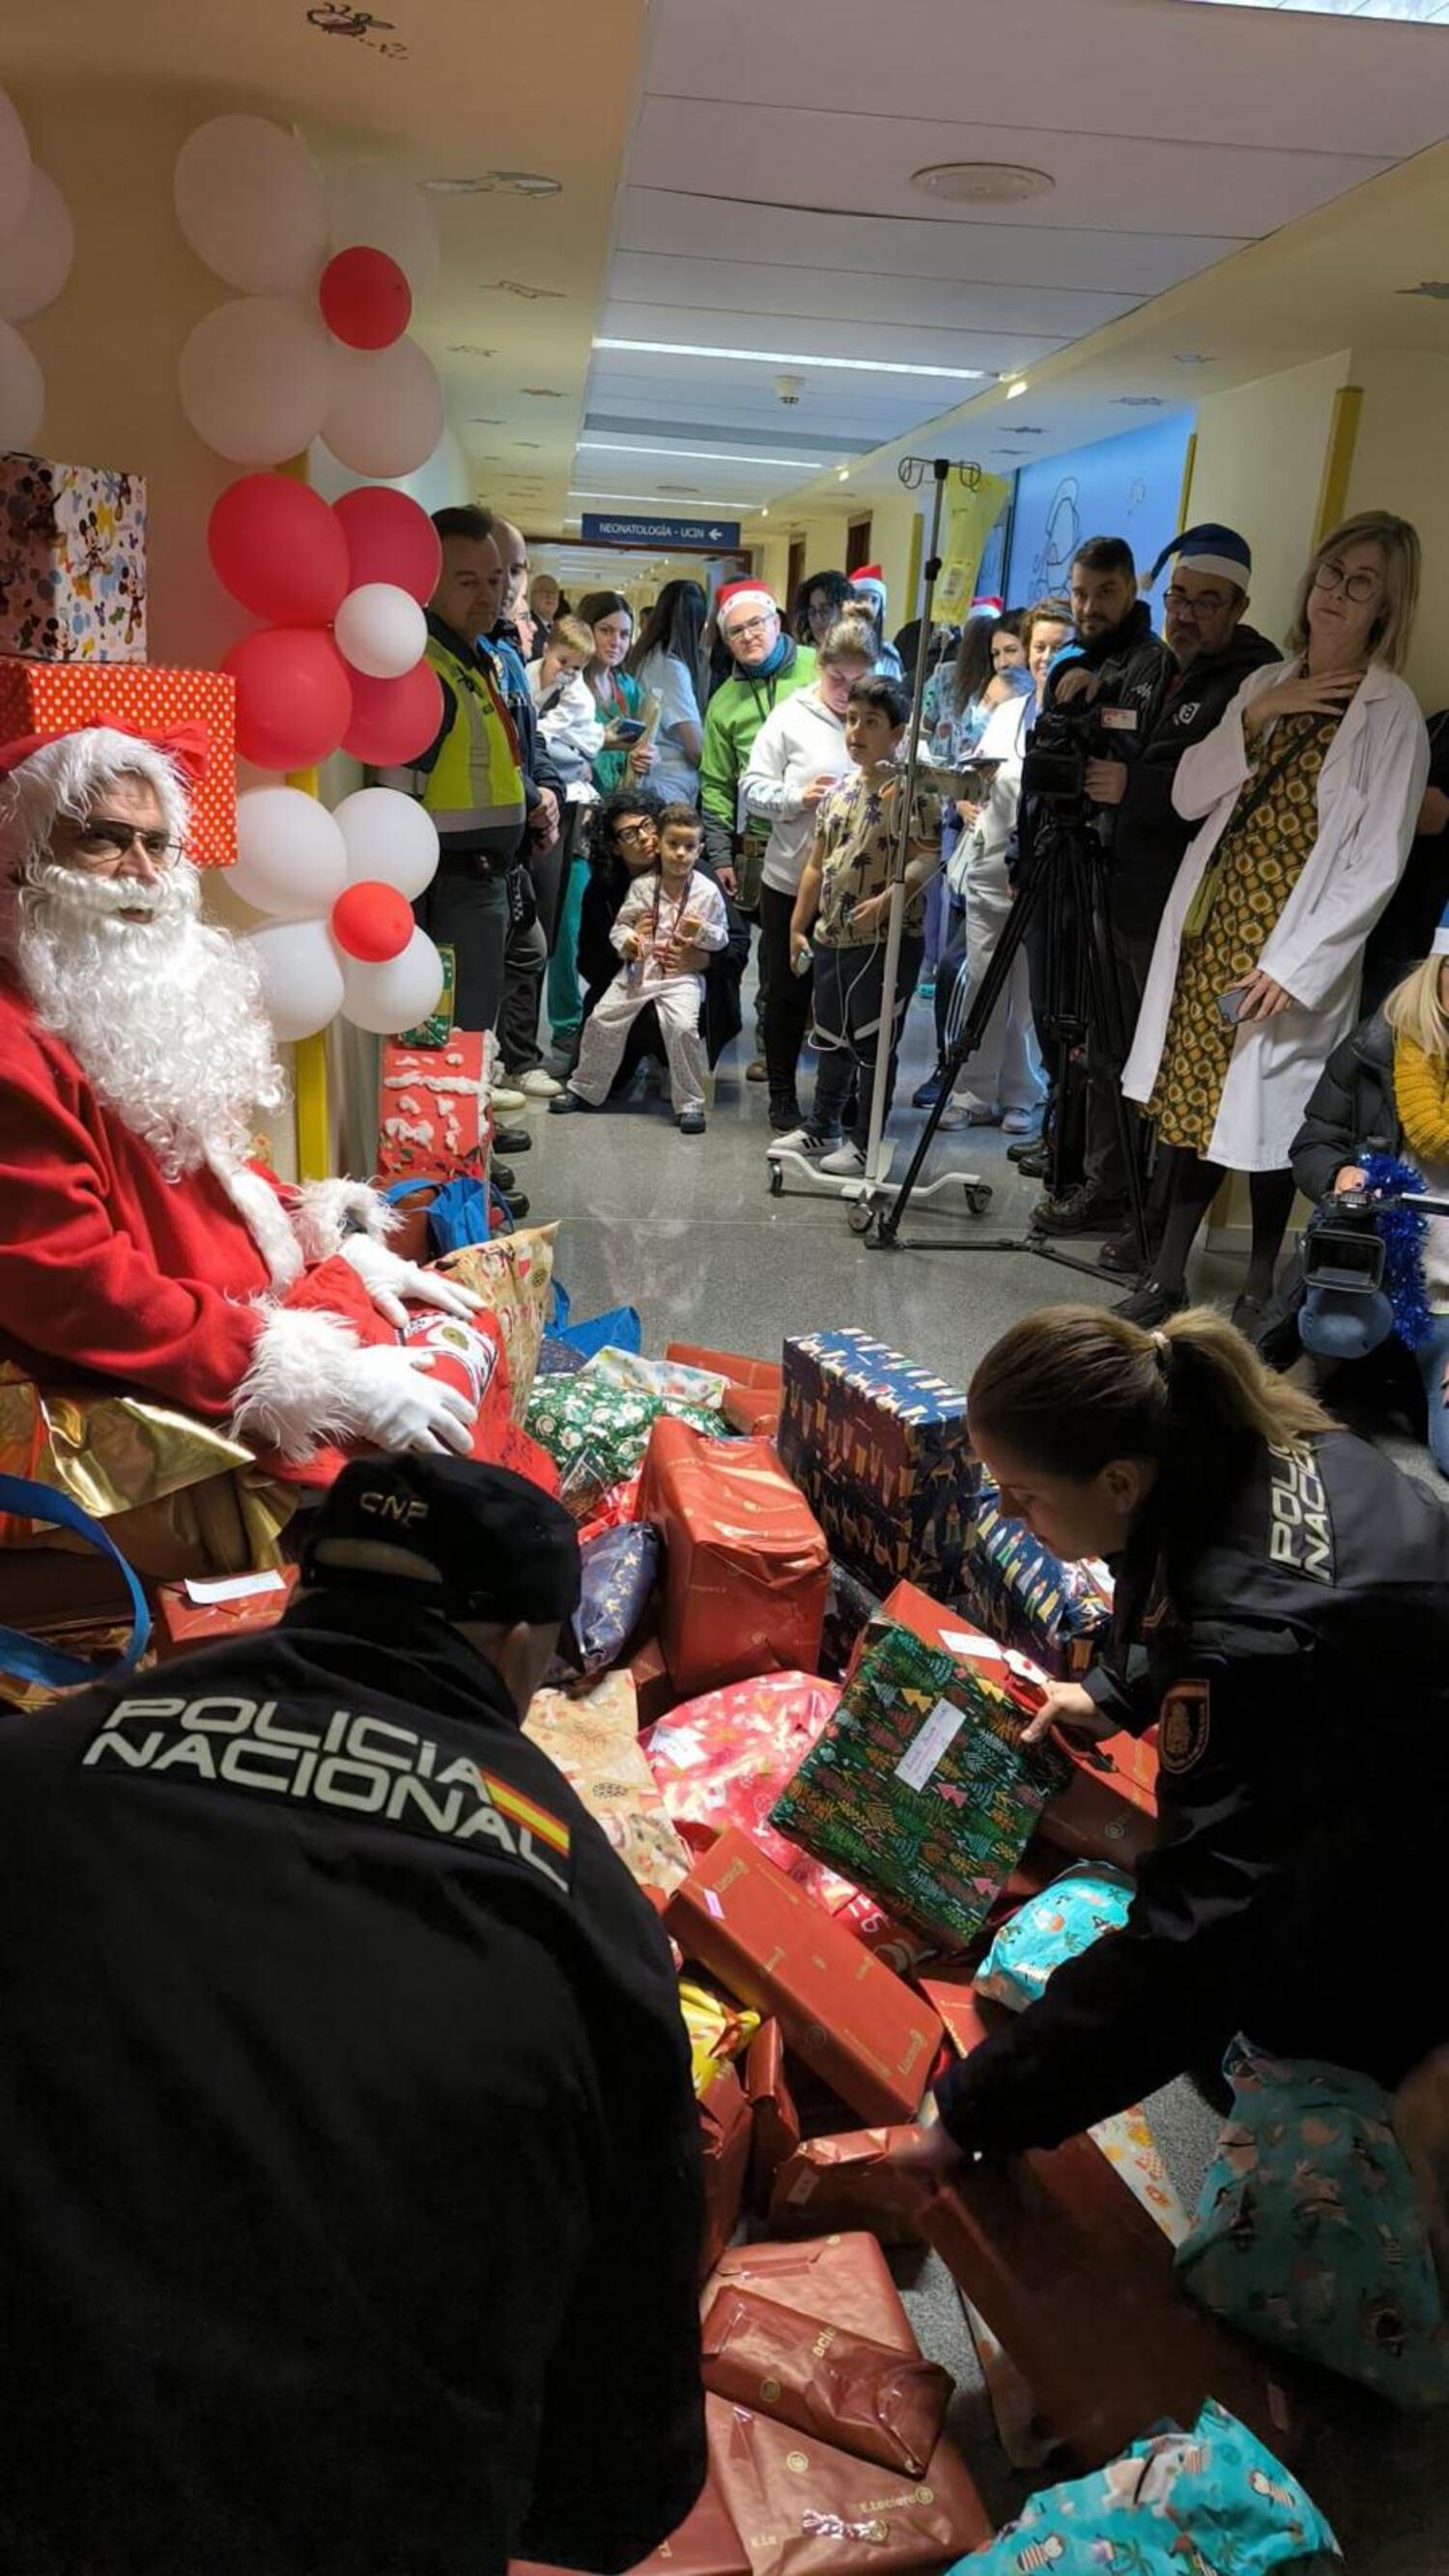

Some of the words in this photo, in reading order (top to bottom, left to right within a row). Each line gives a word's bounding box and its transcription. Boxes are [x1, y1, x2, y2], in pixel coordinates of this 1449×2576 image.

[599, 523, 672, 537] NEONATOLOGÍA
[681, 526, 704, 539] UCIN
[360, 1491, 429, 1528] CNP
[82, 1731, 570, 1893] NACIONAL
